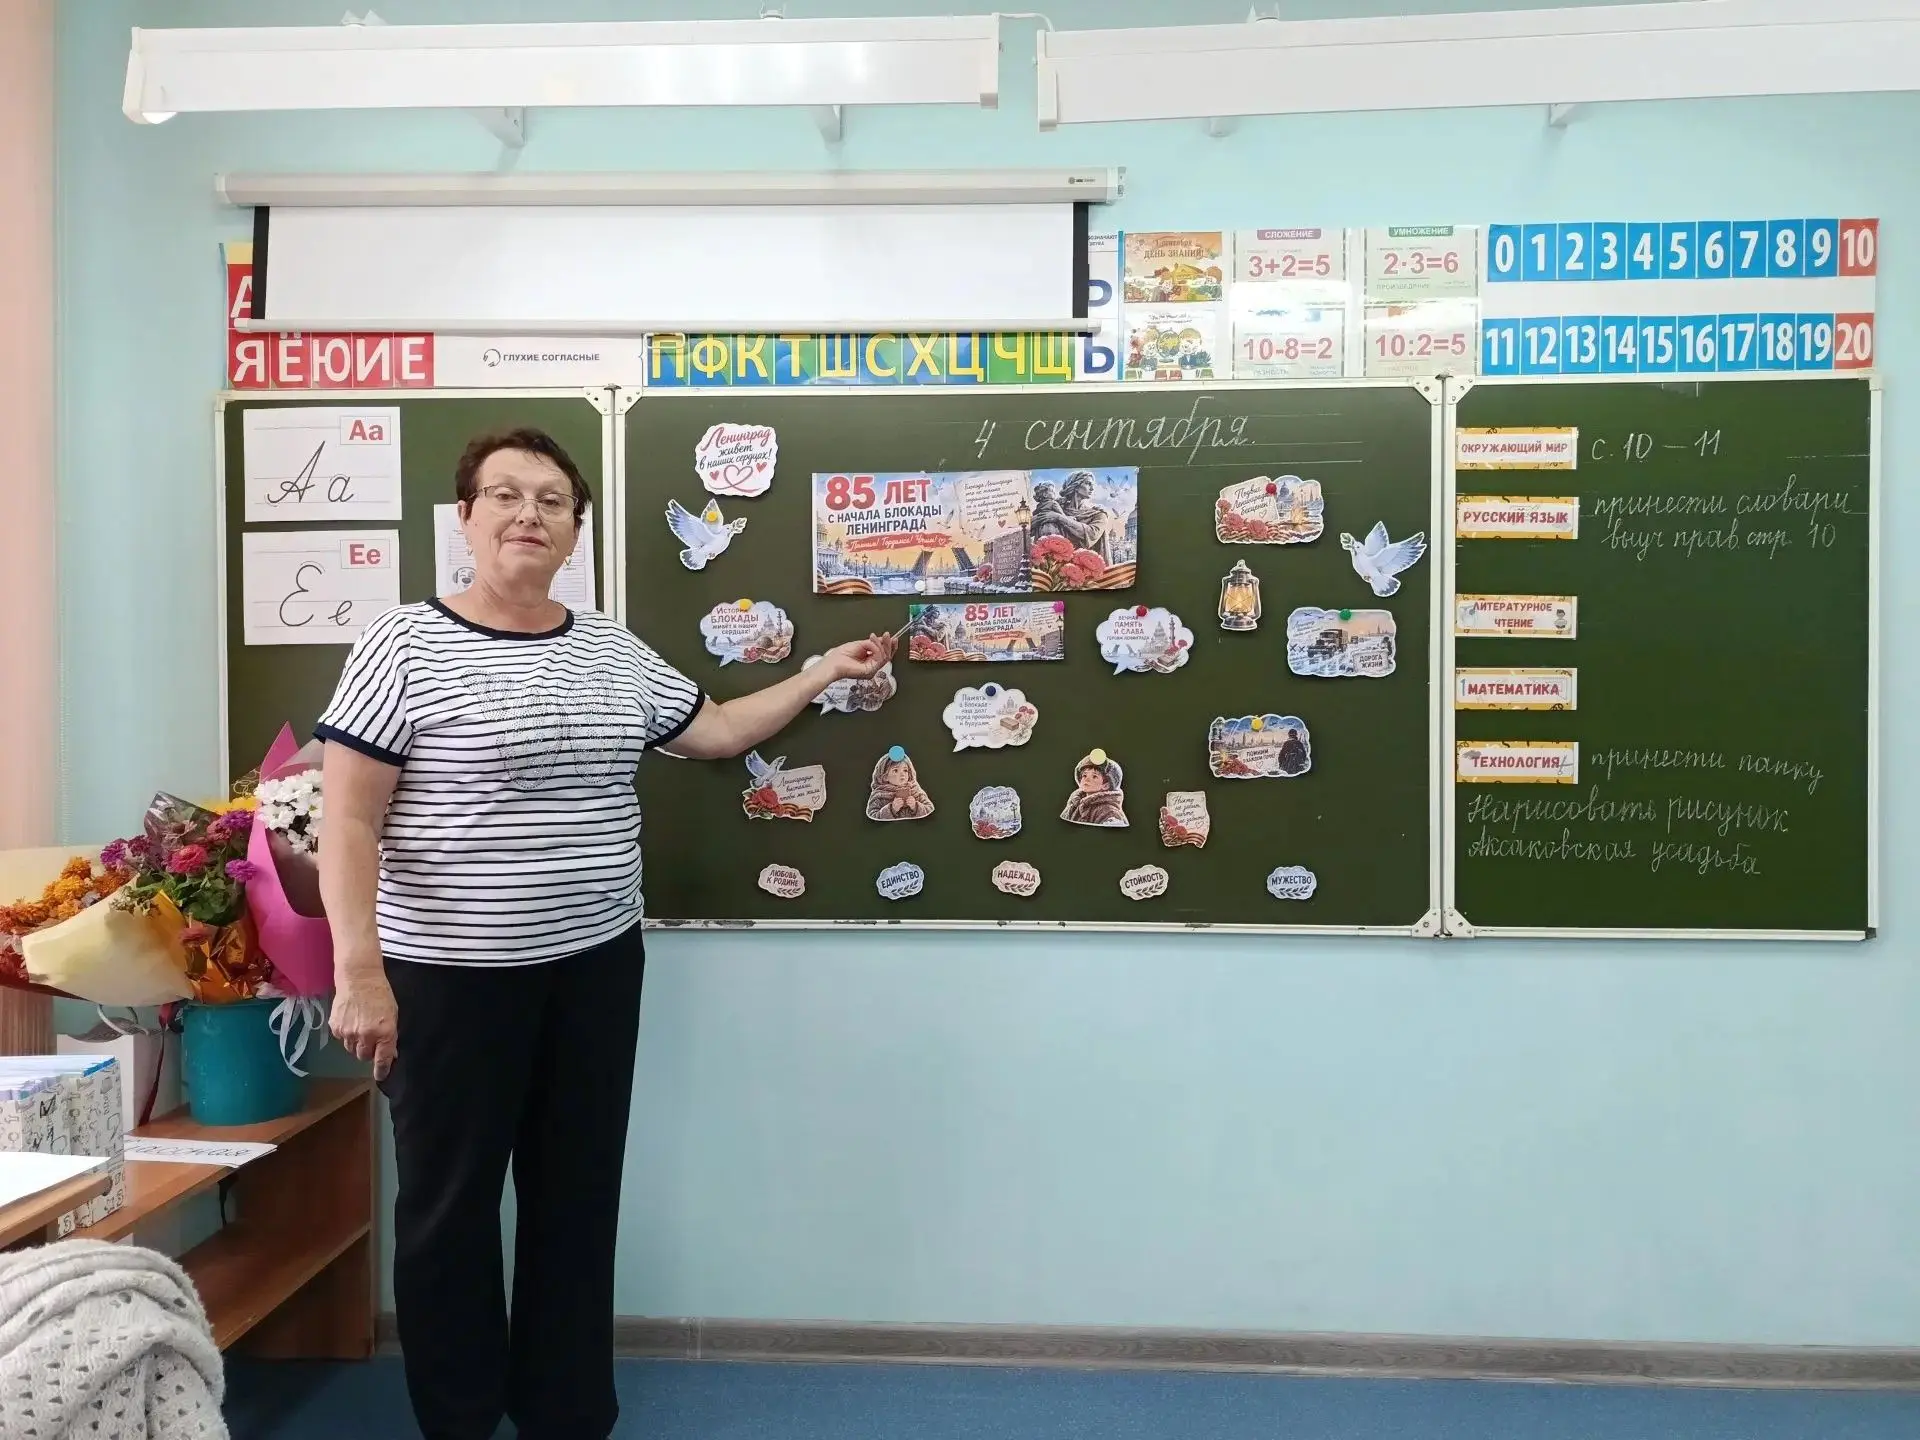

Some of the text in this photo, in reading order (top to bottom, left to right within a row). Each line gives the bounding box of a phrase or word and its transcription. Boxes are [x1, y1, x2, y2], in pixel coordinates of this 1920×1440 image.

[1264, 230, 1314, 239] СЛОЖЕНИЕ
[1393, 227, 1449, 236] УМНОЖЕНИЕ
[1143, 249, 1166, 260] ДЕНЬ
[1495, 228, 1874, 272] 0 1 2 3 4 5 6 7 8 9 10
[1248, 254, 1331, 278] 3+2=5
[1243, 337, 1333, 361] 10-8=2
[1375, 333, 1466, 357] 10:2=5
[1486, 322, 1872, 365] 11 12 13 14 15 16 17 18 19 20
[503, 353, 601, 362] ГЛУХИЕ СОГЛАСНЫЕ
[700, 426, 772, 452] Ленинград
[974, 419, 996, 459] 4
[1623, 432, 1652, 462] 10
[1694, 429, 1721, 458] 11
[718, 442, 754, 458] живет
[1461, 441, 1568, 455] ОКРУЖАЮЩИЙ МИР
[699, 448, 773, 470] в наших сердцах!
[825, 475, 931, 511] 85 ЛЕТ
[1234, 483, 1262, 499] Подвиг
[1594, 473, 1853, 529] принести словари
[828, 504, 942, 524] С НАЧАЛА БЛОКАДЫ
[1462, 509, 1569, 524] РУССКИЙ ЯЗЫК
[846, 518, 928, 536] ЛЕНИНГРАДА
[1807, 522, 1837, 549] 10
[964, 604, 989, 621] 85
[992, 605, 1016, 619] ЛЕТ
[1473, 601, 1553, 612] ЛИТЕРАТУРНОЕ
[710, 614, 759, 624] БЛОКАДЫ
[970, 620, 991, 628] НАЧАЛА
[992, 617, 1022, 626] БЛОКАДЫ
[1494, 618, 1534, 628] ЧТЕНИЕ
[974, 624, 1014, 634] ЛЕНИНГРАДА
[1359, 655, 1383, 663] ДОРОГА
[1361, 661, 1383, 669] ЖИЗНИ
[961, 693, 986, 701] Память
[1467, 683, 1560, 696] МАТЕМАТИКА
[1472, 755, 1561, 769] ТЕХНОЛОГИЯ
[1591, 747, 1824, 796] принести папку
[1467, 784, 1790, 837] Нарисовать рисунок
[1467, 826, 1761, 875] Аксаковская усадьба
[769, 869, 798, 880] ЛЮБОВЬ
[773, 877, 800, 888] РОДИНЕ
[881, 870, 920, 890] ЕДИНСТВО
[997, 869, 1036, 883] НАДЕЖДА
[1124, 871, 1164, 889] СТОЙКОСТЬ
[1271, 875, 1312, 886] МУЖЕСТВО
